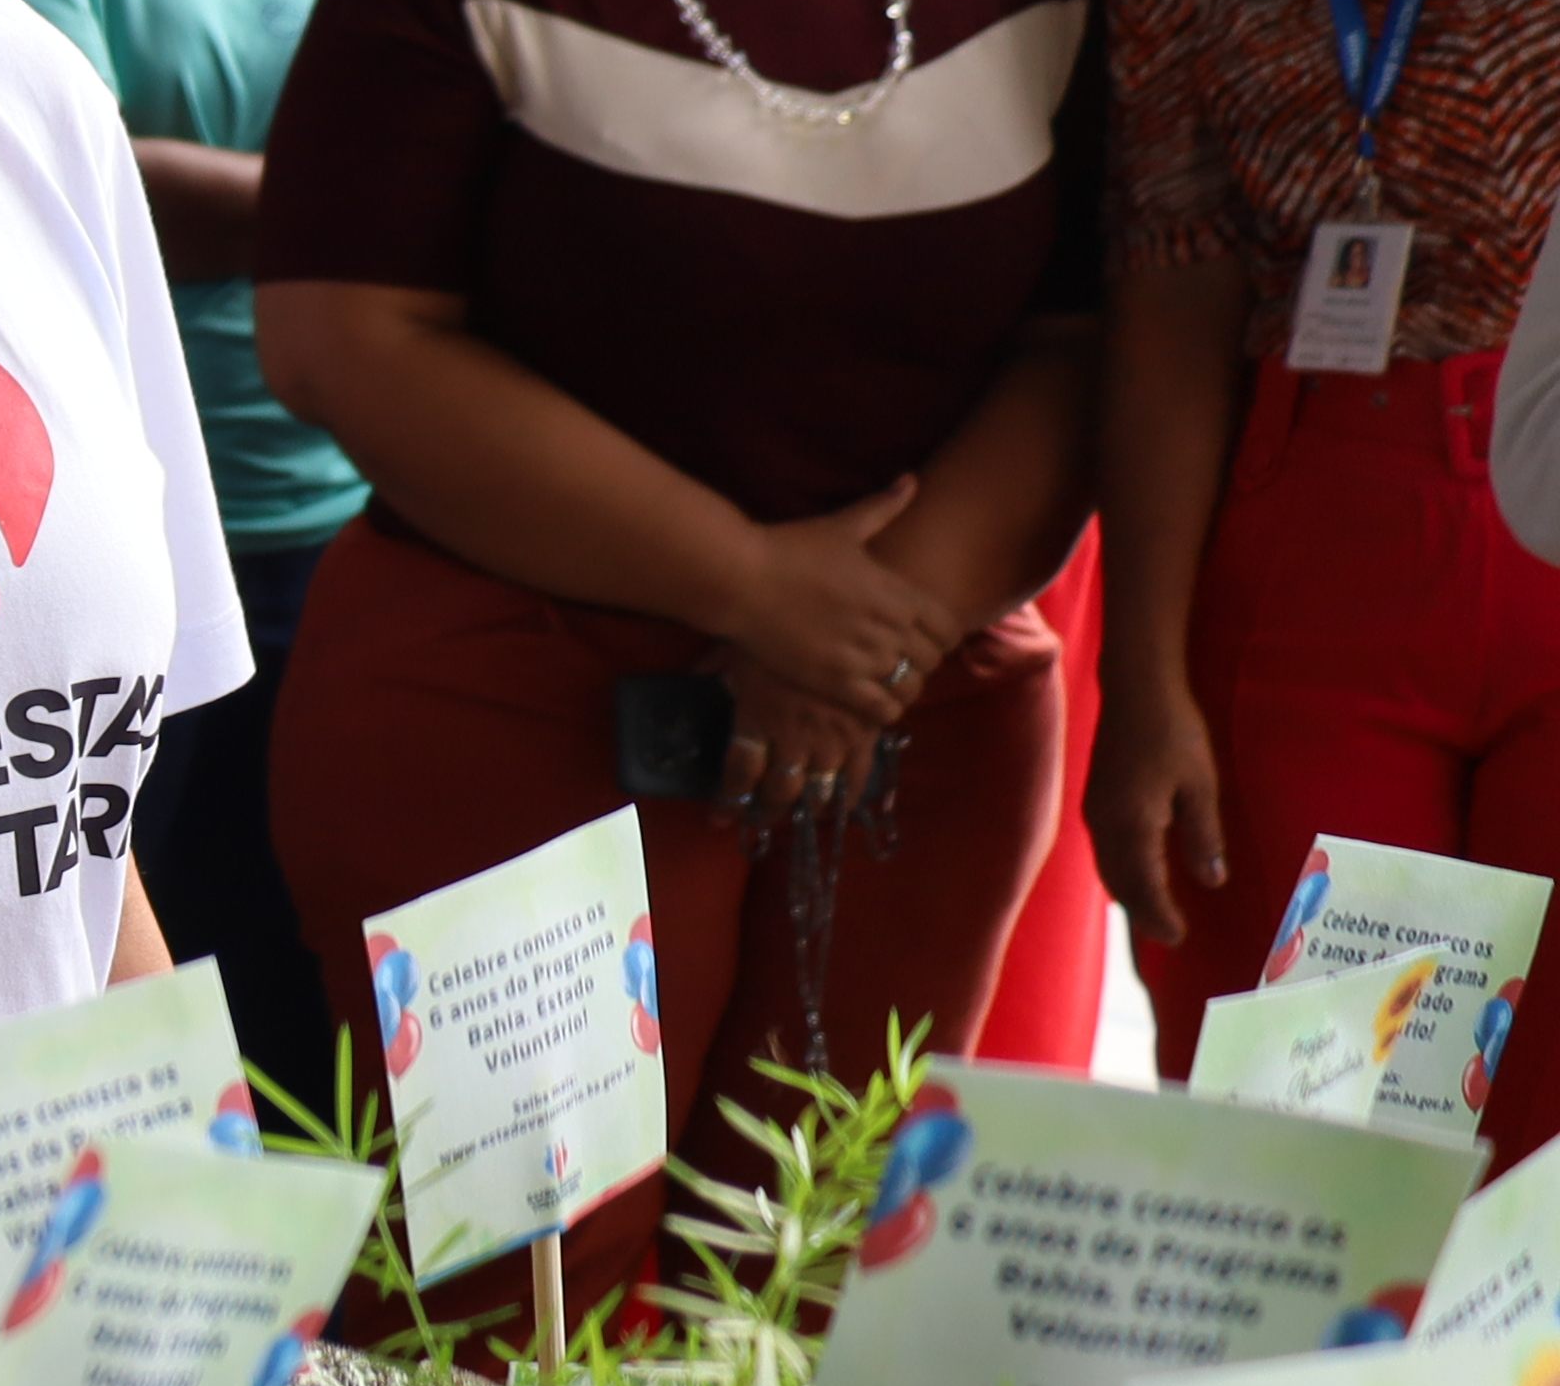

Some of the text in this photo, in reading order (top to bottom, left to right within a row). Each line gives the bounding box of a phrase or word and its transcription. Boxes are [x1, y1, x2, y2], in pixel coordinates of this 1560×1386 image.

[427, 900, 607, 997] Celebre conosco os
[1308, 937, 1320, 958] 6
[1321, 945, 1368, 964] anos
[1322, 908, 1390, 940] Celebre
[1474, 941, 1494, 959] os
[429, 930, 616, 1031] 6 anos do Programa
[1414, 989, 1454, 1014] tado
[1433, 964, 1489, 989] grama
[467, 975, 596, 1049] Bahia. Estado
[483, 1008, 590, 1075] Voluntário!
[35, 1074, 143, 1125] conosco
[972, 1161, 1120, 1217] Celebre
[1131, 1189, 1292, 1243] conosco
[1151, 1234, 1343, 1295] Programa
[1134, 1275, 1265, 1328] Estado
